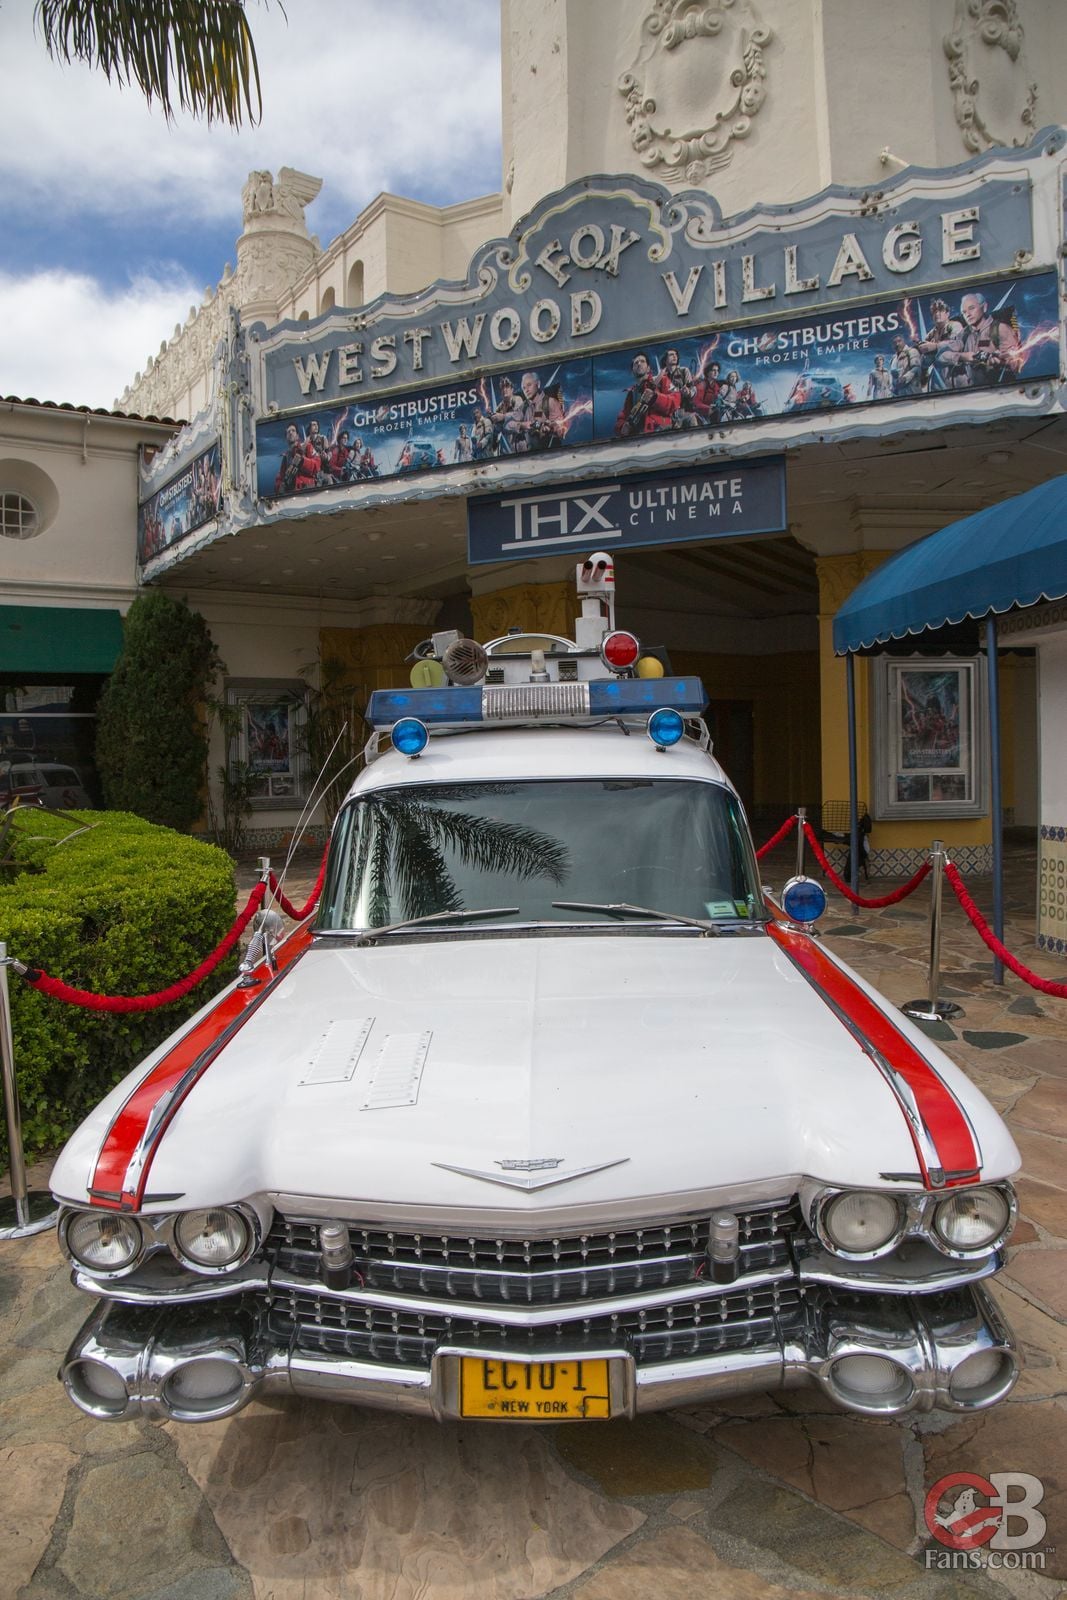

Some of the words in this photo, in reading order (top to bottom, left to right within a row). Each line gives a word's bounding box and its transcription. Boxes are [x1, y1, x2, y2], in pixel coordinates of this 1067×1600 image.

[534, 223, 641, 288] FOX
[292, 290, 602, 395] WESTWOOD
[661, 206, 981, 316] VILLAGE
[755, 349, 809, 366] FROZEN
[817, 338, 870, 356] EMPIRE
[374, 420, 412, 434] FROZEN
[418, 411, 456, 426] EMPIRE
[629, 478, 743, 509] ULTIMATE
[501, 485, 622, 540] THX
[629, 500, 743, 526] CINEMA
[501, 1401, 529, 1412] NEW
[536, 1401, 568, 1413] YORK
